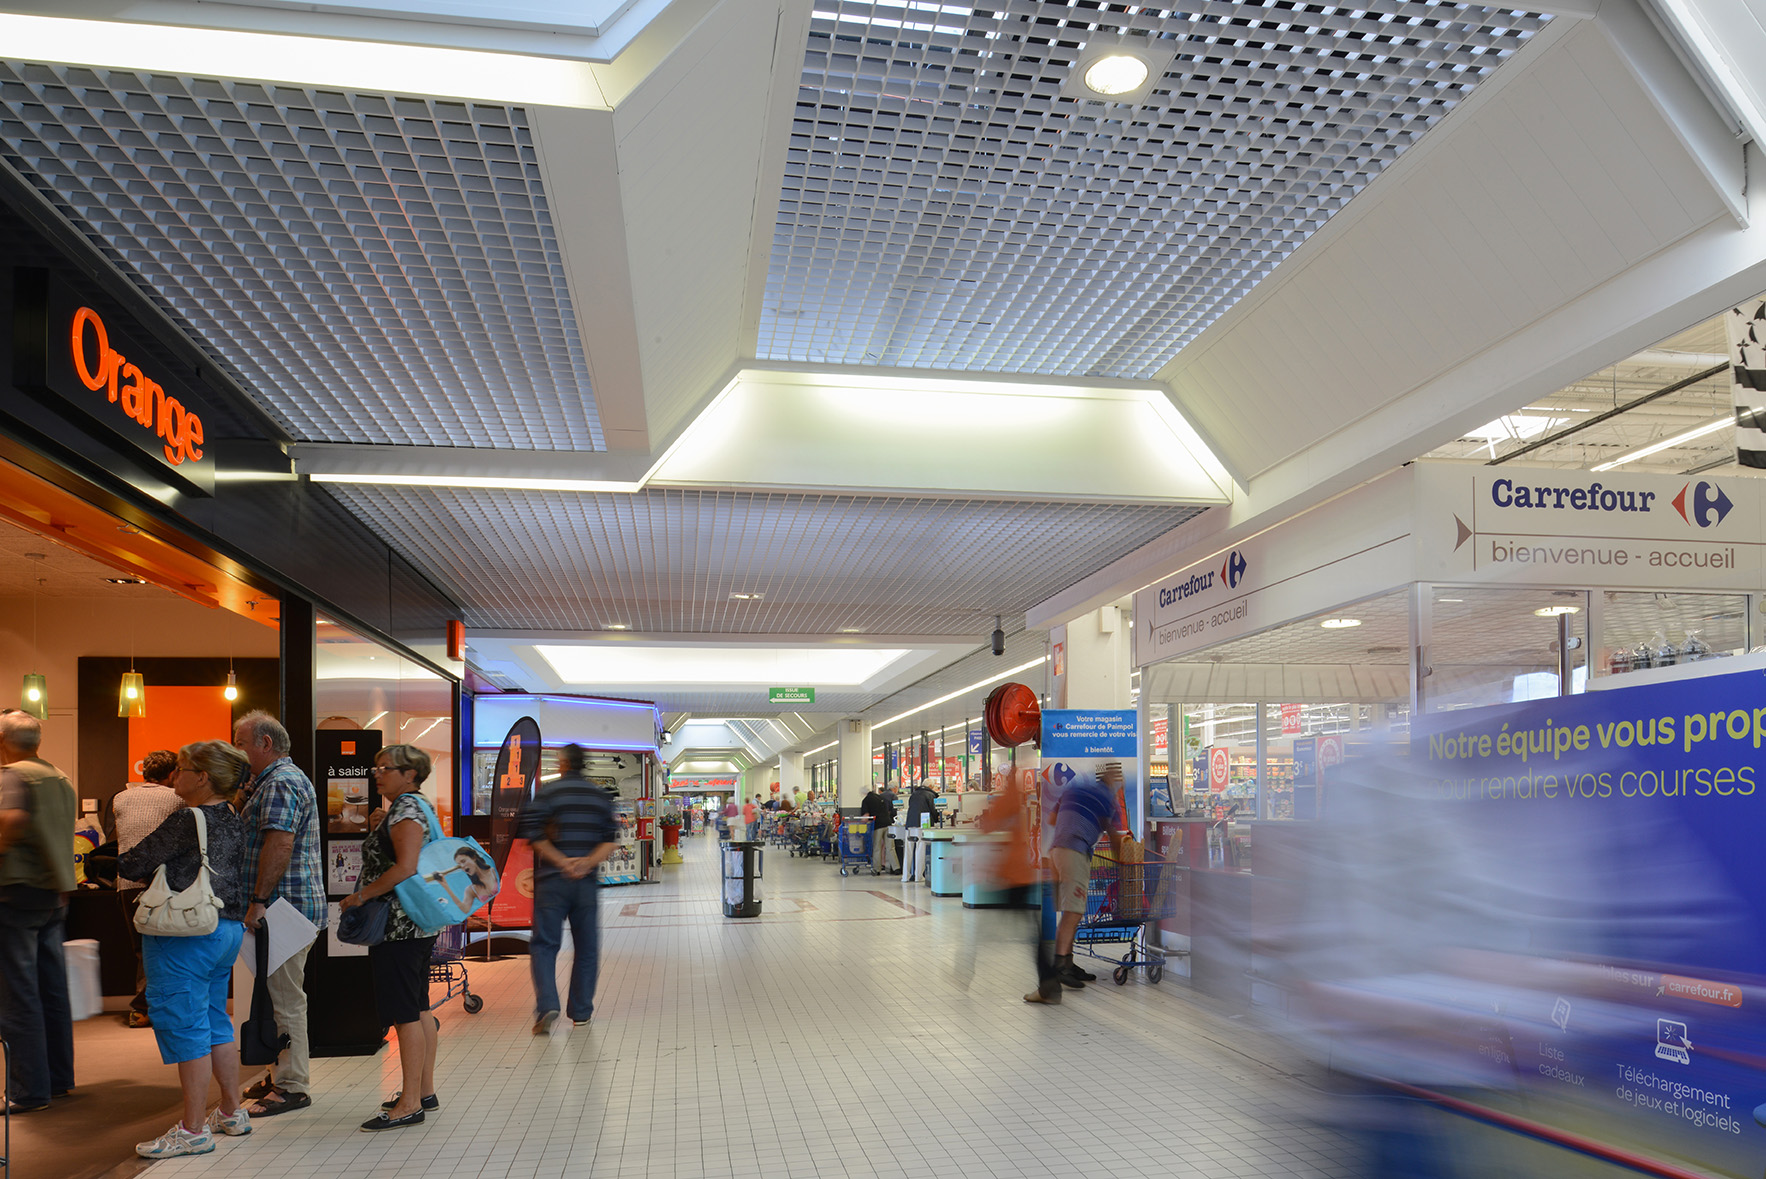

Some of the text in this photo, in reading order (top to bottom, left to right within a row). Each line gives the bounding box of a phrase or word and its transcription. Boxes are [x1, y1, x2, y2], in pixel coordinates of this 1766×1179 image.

[71, 306, 204, 466] Orange
[1492, 478, 1655, 512] Carrefour
[1492, 540, 1628, 566] bienvenue
[1649, 548, 1734, 568] accueil
[1160, 570, 1214, 608] Carrefour
[1160, 620, 1204, 645] bienvenue
[1211, 600, 1248, 628] accueil
[1107, 723, 1134, 731] Paimpol
[1429, 732, 1492, 760] Notre
[1496, 718, 1590, 762] équipe
[1596, 716, 1676, 748] vous
[328, 766, 368, 776] à saisir
[507, 777, 511, 786] 2
[1480, 768, 1558, 800] rendre
[1564, 772, 1612, 798] vos
[1620, 766, 1756, 798] courses
[1632, 974, 1733, 1001] sur carrefour.fr
[1539, 1042, 1564, 1061] Liste
[1539, 1063, 1585, 1087] cadeaux
[1616, 1064, 1730, 1110] Téléchargement
[1616, 1085, 1741, 1134] de jeux et logiciels
